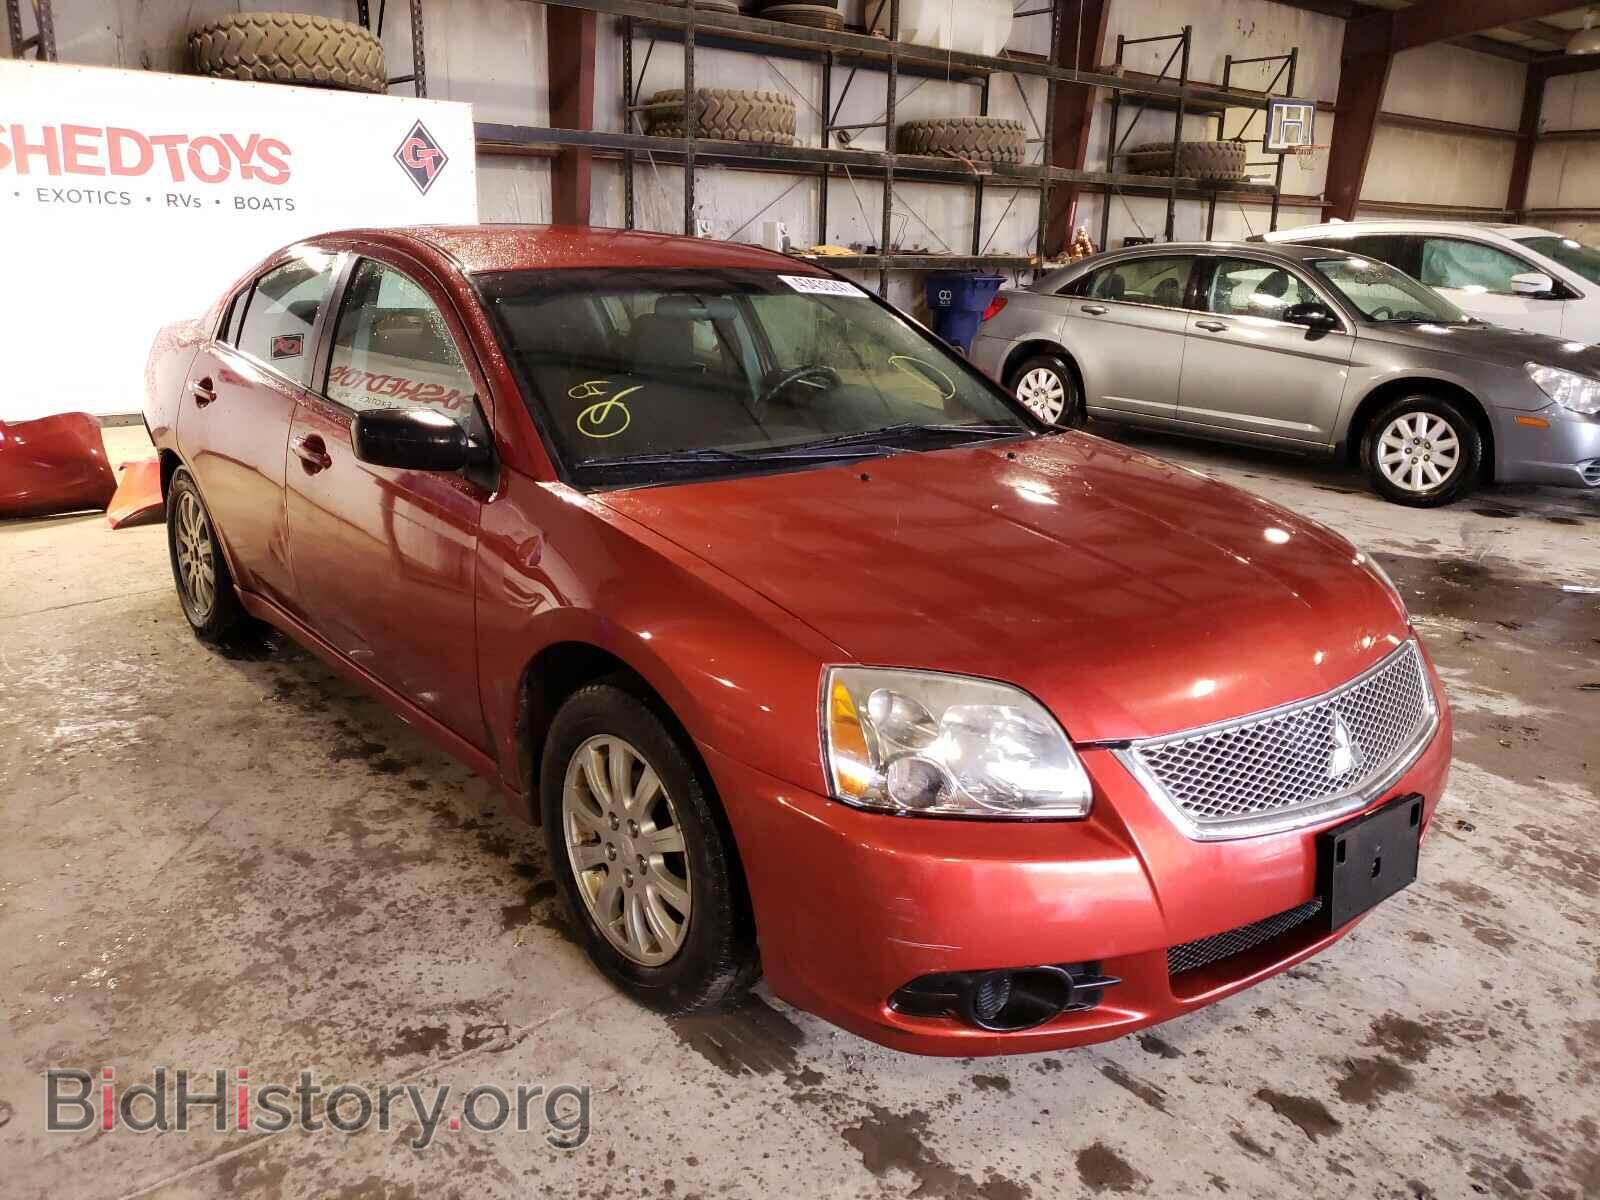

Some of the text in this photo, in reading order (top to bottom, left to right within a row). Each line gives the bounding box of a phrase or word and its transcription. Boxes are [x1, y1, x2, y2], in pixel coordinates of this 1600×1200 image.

[36, 187, 295, 212] EXOTICS RVs BOATS
